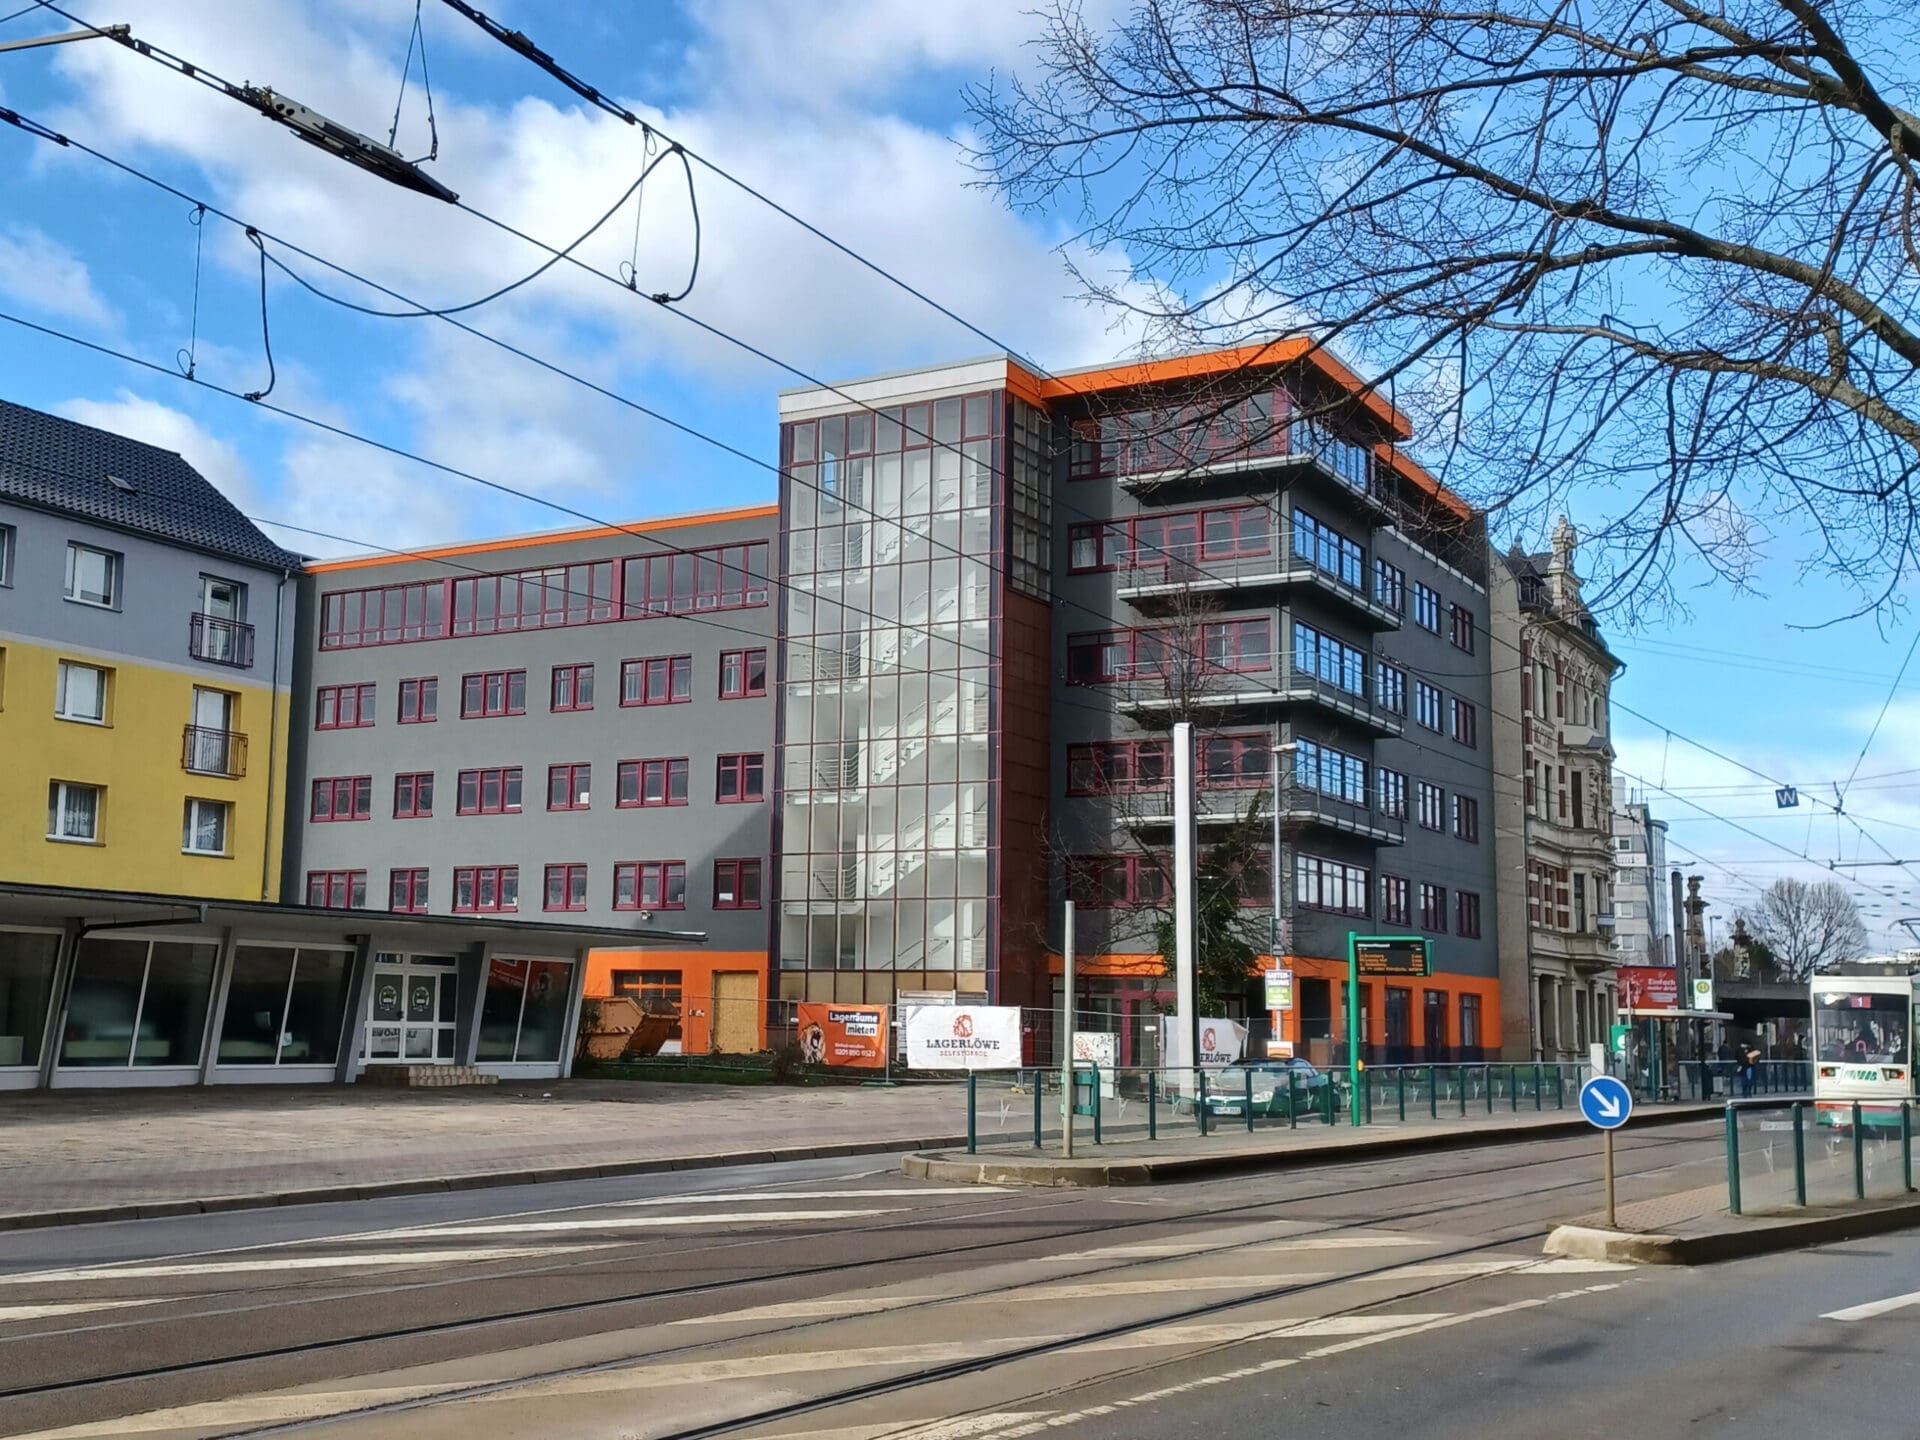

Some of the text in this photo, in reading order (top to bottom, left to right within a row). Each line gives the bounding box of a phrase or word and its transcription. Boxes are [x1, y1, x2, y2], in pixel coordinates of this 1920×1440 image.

[1777, 790, 1796, 806] W
[830, 1012, 878, 1024] Lagerräume
[847, 1025, 875, 1034] mieten
[926, 1038, 1000, 1050] LAGERLÖWE
[1200, 1051, 1231, 1063] ERLÖWE
